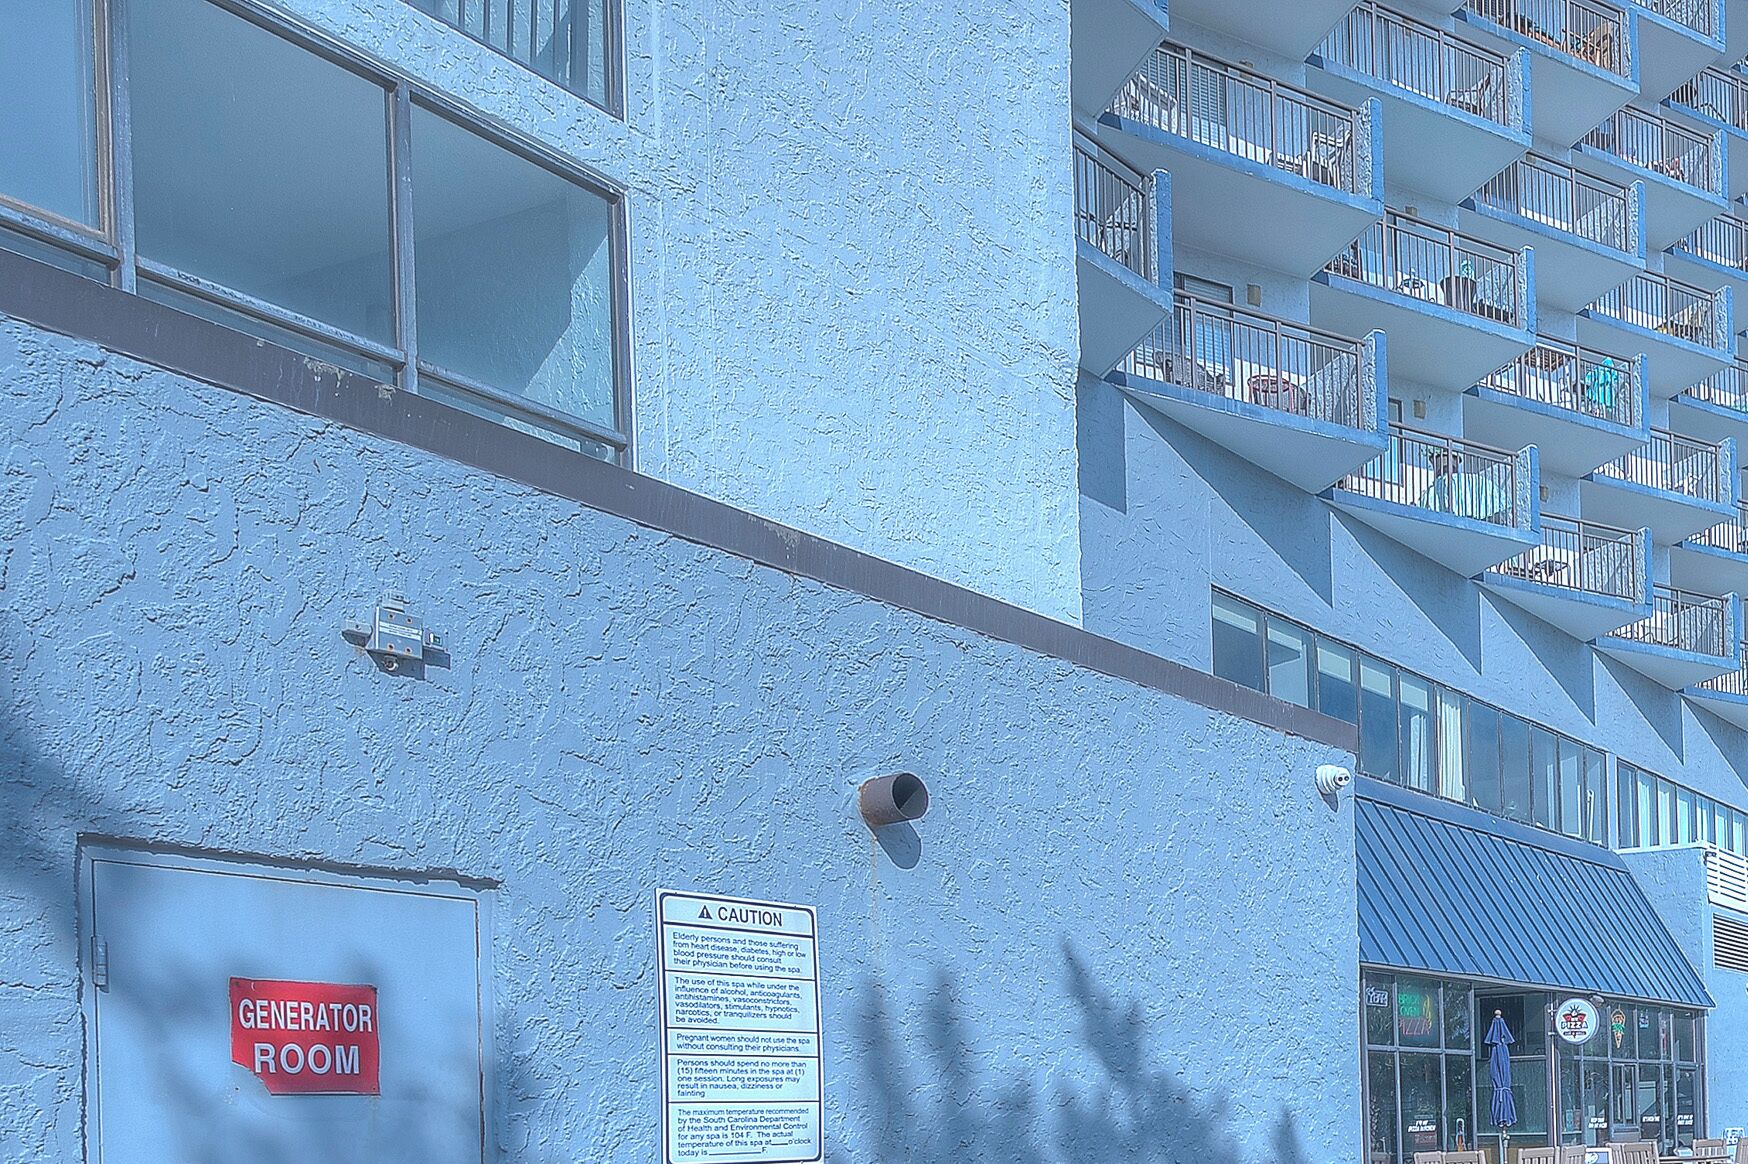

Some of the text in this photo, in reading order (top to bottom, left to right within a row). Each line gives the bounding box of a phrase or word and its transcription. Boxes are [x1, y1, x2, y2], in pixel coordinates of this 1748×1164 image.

[717, 906, 782, 927] CAUTION
[672, 931, 699, 943] Elderly
[700, 935, 730, 944] persons
[747, 939, 767, 947] those
[768, 941, 798, 952] suffering
[672, 940, 689, 948] from
[690, 942, 709, 950] heart
[771, 949, 785, 957] high
[672, 949, 781, 964] blood pressure should consult
[673, 957, 690, 965] their
[692, 959, 727, 968] physician
[729, 961, 752, 969] before
[754, 963, 773, 973] using
[674, 976, 689, 984] The
[706, 978, 716, 986] of
[716, 979, 730, 987] this
[674, 984, 708, 993] influence
[238, 998, 373, 1033] GENERATOR
[675, 1015, 685, 1023] be
[1561, 1021, 1588, 1029] PIZZA
[676, 1032, 709, 1043] Pregnant
[676, 1042, 704, 1050] without
[705, 1043, 743, 1052] consulting
[253, 1043, 360, 1075] ROOM
[676, 1058, 708, 1066] Persons
[710, 1059, 734, 1067] should
[676, 1066, 693, 1075] (15)
[794, 1068, 805, 1076] (1)
[726, 1075, 745, 1083] Long
[784, 1076, 800, 1084] may
[677, 1108, 690, 1116] The
[725, 1108, 764, 1117] temperature
[765, 1107, 809, 1115] recommended
[677, 1117, 687, 1126] by
[702, 1116, 725, 1124] South
[759, 1115, 800, 1124] Department
[677, 1124, 686, 1132] of
[782, 1122, 807, 1130] Control
[771, 1130, 793, 1138] actual
[677, 1140, 724, 1149] temperature
[725, 1139, 733, 1147] of
[787, 1137, 810, 1145] o'clock
[677, 1149, 699, 1157] today
